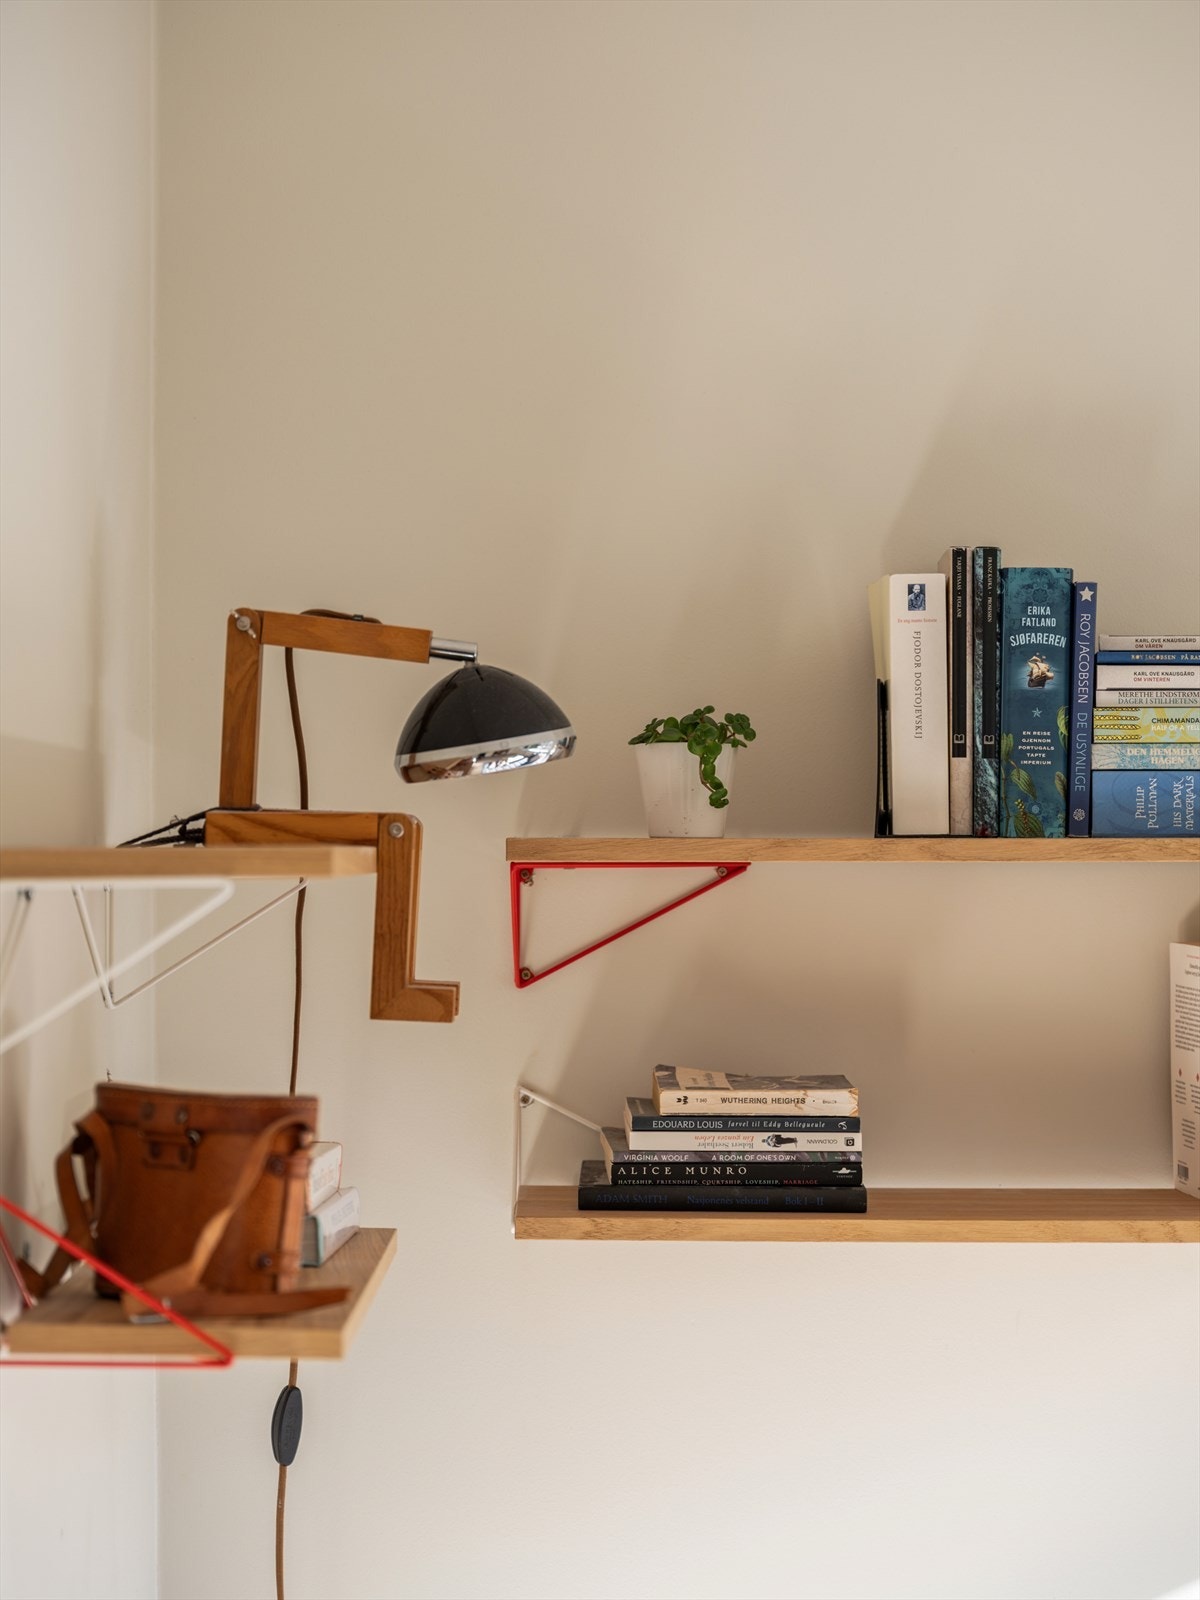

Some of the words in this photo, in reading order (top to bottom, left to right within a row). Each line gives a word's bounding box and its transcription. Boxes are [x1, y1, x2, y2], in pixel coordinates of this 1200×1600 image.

[1022, 617, 1056, 627] FATLAND
[1027, 606, 1051, 615] ERIKA
[1080, 614, 1091, 638] ROY
[913, 631, 921, 668] FJODOR
[1009, 633, 1067, 648] SJØFAREREN
[1077, 640, 1090, 703] JACOBSEN
[913, 672, 922, 739] DOSTOJEVSKIJ
[1076, 712, 1088, 728] DE
[1075, 733, 1087, 792] USYNLIGE
[1135, 786, 1146, 819] PHILIP
[1147, 778, 1159, 828] PULLMAN
[1173, 777, 1184, 808] DARK
[1185, 775, 1196, 831] MATERIALS
[1173, 812, 1182, 827] HIS
[697, 1121, 723, 1129] LOUIS
[618, 1166, 672, 1175] ALICE
[685, 1166, 747, 1175] MUNRO
[595, 1195, 628, 1203] ADAM
[633, 1195, 668, 1203] SMITH
[687, 1195, 733, 1206] Nasjonenes
[735, 1196, 769, 1205] velstand
[785, 1196, 800, 1205] Bok
